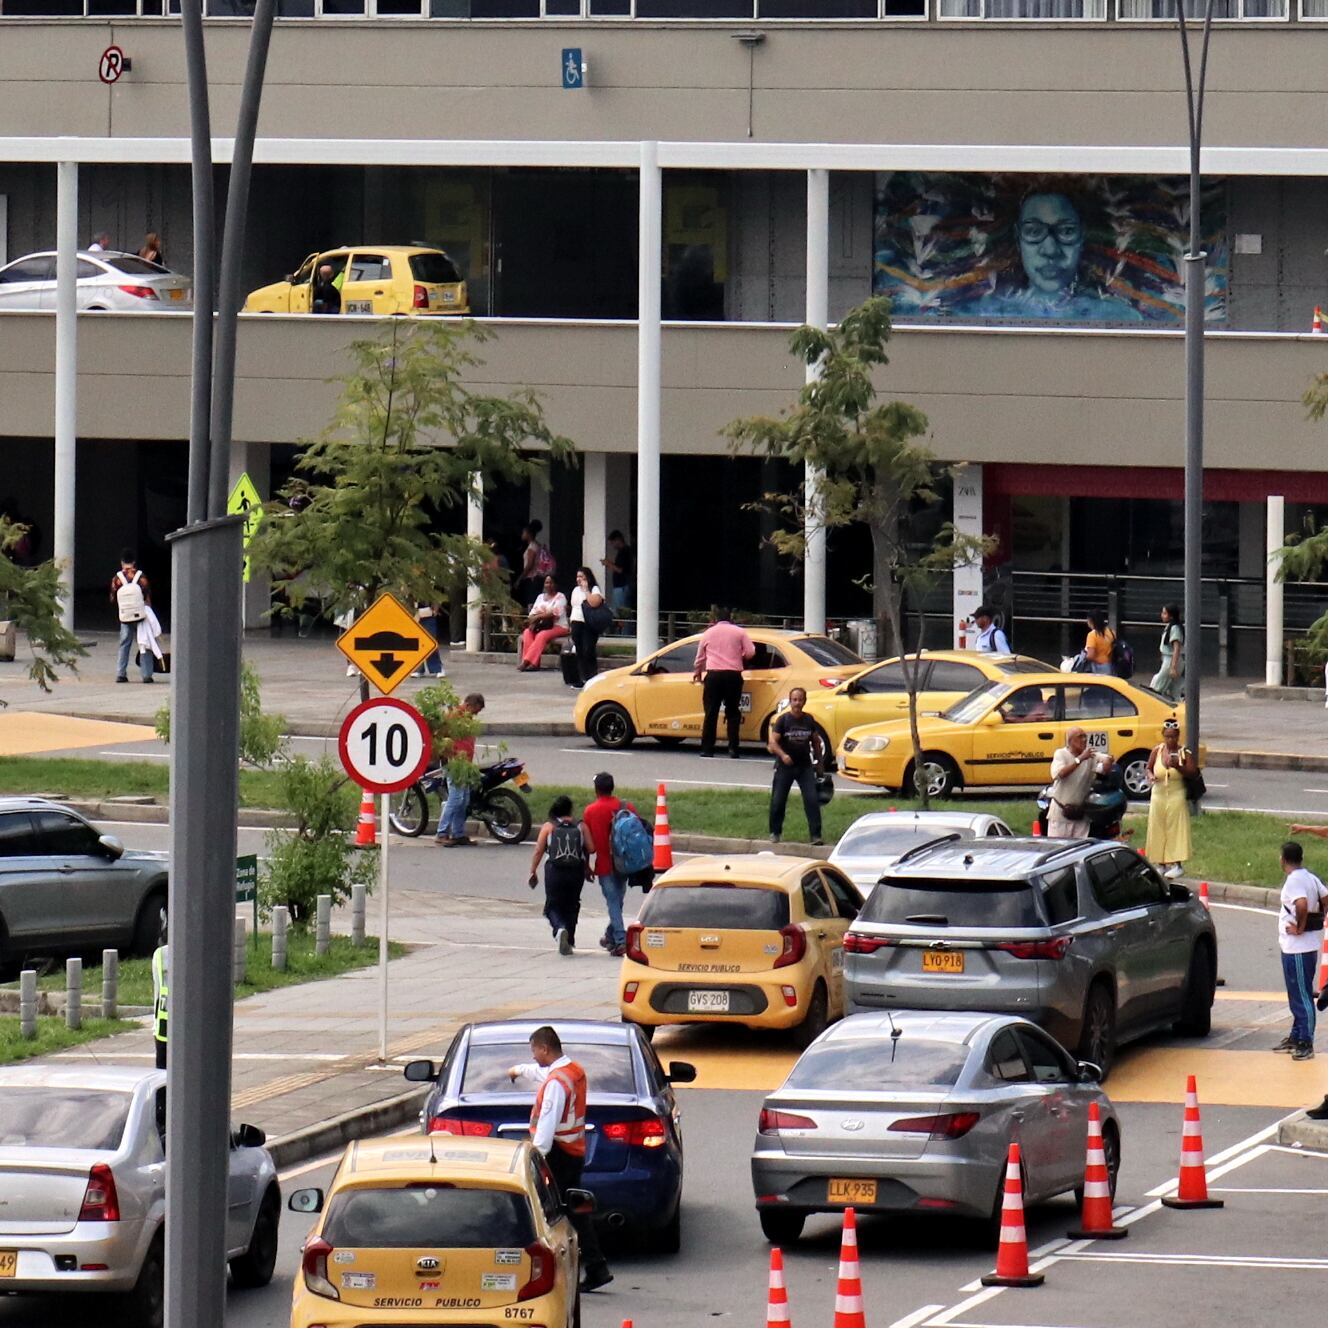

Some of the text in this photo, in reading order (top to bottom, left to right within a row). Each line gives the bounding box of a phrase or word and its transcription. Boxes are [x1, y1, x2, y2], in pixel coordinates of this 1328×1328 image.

[360, 722, 409, 767] 10
[677, 963, 741, 973] SERVICIO PUBLICO
[420, 1259, 436, 1268] KIA
[373, 1297, 482, 1307] SERVICIO PUBLICO
[504, 1307, 536, 1320] 8767
